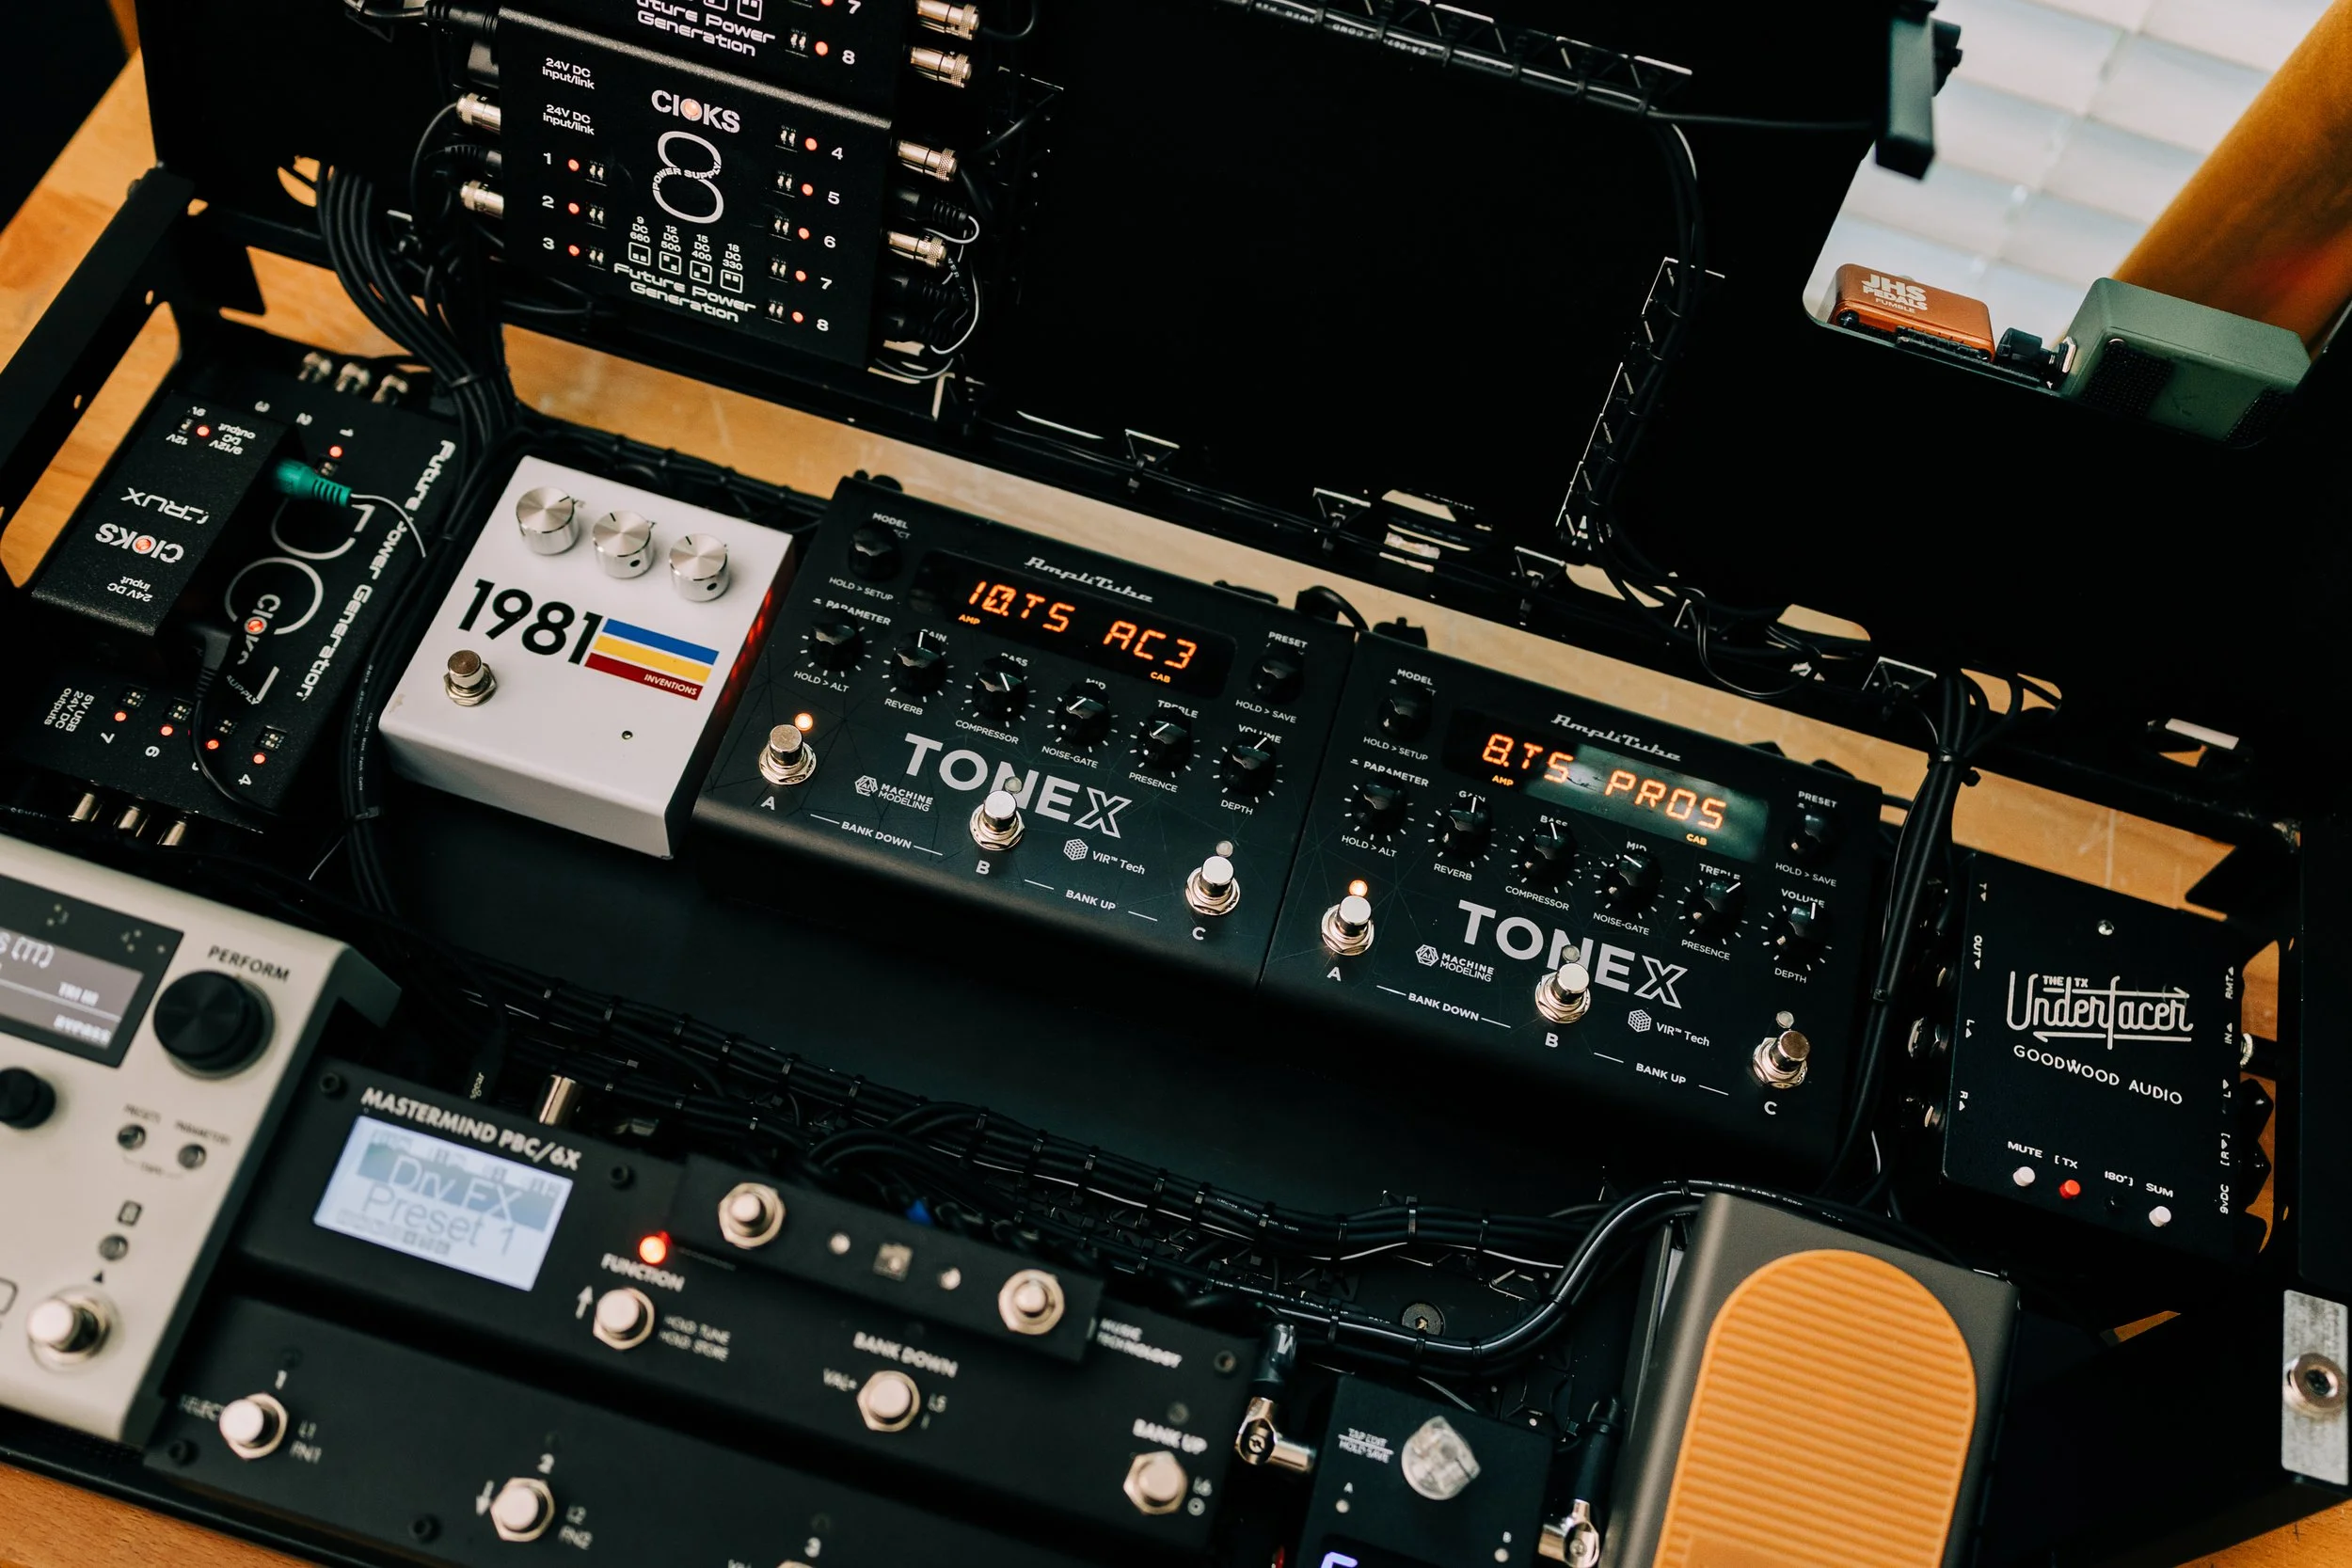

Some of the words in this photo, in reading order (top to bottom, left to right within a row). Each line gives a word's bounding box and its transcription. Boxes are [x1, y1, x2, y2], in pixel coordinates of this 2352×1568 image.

[637, 9, 756, 56] Generation
[705, 13, 776, 43] Power
[545, 56, 571, 75] 24V
[572, 63, 592, 78] DC
[841, 49, 856, 66] 8
[542, 65, 595, 90] input/link
[546, 103, 571, 122] 24V
[572, 110, 592, 125] DC
[651, 89, 741, 134] CIOKS
[543, 112, 595, 136] input/link
[543, 152, 553, 166] 1
[831, 146, 844, 161] 4
[652, 166, 682, 192] POWER
[683, 160, 723, 181] SUPPLY
[541, 195, 555, 209] 2
[827, 190, 841, 206] 5
[630, 231, 651, 245] 660
[632, 224, 649, 235] DC
[662, 232, 679, 244] DC
[664, 225, 678, 235] 12
[695, 233, 709, 244] 15
[542, 236, 555, 250] 3
[660, 241, 682, 253] 500
[693, 242, 710, 253] DC
[726, 243, 739, 253] 18
[823, 235, 837, 249] 6
[691, 249, 712, 262] 400
[722, 259, 743, 271] 330
[724, 250, 741, 261] DC
[613, 262, 687, 293] Future
[691, 286, 756, 313] Power
[819, 277, 834, 291] 7
[1861, 274, 1927, 302] JHS
[630, 281, 739, 323] Generation
[1863, 285, 1928, 310] PEDALS
[816, 318, 830, 333] 8
[254, 400, 271, 413] 3
[295, 411, 313, 426] 2
[167, 434, 188, 447] 12V
[218, 422, 256, 440] output
[221, 434, 242, 446] DC
[339, 428, 355, 438] 1
[209, 439, 244, 456] 9/12V
[404, 439, 457, 512] Future
[119, 486, 210, 526] CRUX
[872, 511, 910, 531] MODEL
[95, 523, 185, 564] CIOKS
[107, 581, 129, 594] DC
[119, 576, 151, 592] input
[828, 576, 855, 592] HOLD
[864, 586, 894, 603] SETUP
[1023, 555, 1154, 605] AmpliTube
[127, 588, 153, 603] 24V
[457, 577, 604, 666] 1981
[958, 612, 982, 626] AMP
[1102, 619, 1199, 671] AC3
[1267, 630, 1310, 650] PRESET
[643, 672, 698, 697] INVENTIONS
[792, 670, 822, 687] HOLD
[829, 680, 850, 693] ALT
[1149, 670, 1172, 685] CAB
[1396, 668, 1434, 687] MODEL
[43, 688, 73, 726] outputs
[68, 690, 85, 713] 24V
[80, 694, 95, 710] 5V
[883, 697, 924, 717] REVERB
[1234, 698, 1263, 714] HOLD
[1271, 709, 1298, 725] SAVE
[54, 711, 72, 731] DC
[65, 708, 87, 733] USB
[101, 732, 115, 744] 7
[954, 720, 1020, 746] COMPRESSOR
[1550, 712, 1682, 763] AmpliTube
[144, 745, 161, 758] 6
[1041, 745, 1100, 769] NOISE-GATE
[1362, 736, 1391, 751] HOLD
[1398, 745, 1430, 763] SETUP
[237, 773, 252, 786] 4
[903, 732, 1133, 839] TONEX
[1128, 770, 1179, 794] PRESENCE
[1491, 774, 1515, 787] AMP
[760, 795, 776, 811] A
[877, 789, 930, 814] MODELING
[881, 782, 934, 805] MACHINE
[1603, 768, 1728, 831] PROS
[1797, 789, 1838, 809] PRESET
[1220, 799, 1254, 816] DEPTH
[840, 820, 875, 839] BANK
[874, 830, 914, 848] DOWN
[1685, 832, 1708, 847] CAB
[1341, 834, 1370, 851] HOLD
[1377, 845, 1398, 859] ALT
[975, 860, 991, 876] B
[1119, 856, 1146, 876] Tech
[1433, 862, 1473, 881] REVERB
[1774, 862, 1804, 878] HOLD
[1811, 873, 1837, 888] SAVE
[1064, 889, 1099, 907] BANK
[1099, 897, 1117, 912] UP
[1504, 884, 1570, 911] COMPRESSOR
[1191, 926, 1207, 942] C
[1592, 911, 1650, 936] NOISE-GATE
[1457, 899, 1689, 1009] TONEX
[1680, 939, 1731, 961] PRESENCE
[1972, 934, 1983, 959] OUT
[207, 943, 292, 984] PERFORM
[1327, 965, 1343, 982] A
[1438, 959, 1493, 983] MODELING
[1440, 952, 1496, 976] MACHINE
[1774, 966, 1808, 985] DEPTH
[2042, 974, 2065, 987] THE
[2074, 976, 2090, 989] TX
[2223, 974, 2235, 1001] RMT
[1407, 991, 1440, 1010] BANK
[1441, 1002, 1480, 1022] DOWN
[2006, 970, 2194, 1051] Underfacer
[1544, 1032, 1559, 1049] B
[1683, 1031, 1710, 1048] Tech
[1635, 1062, 1670, 1081] BANK
[1670, 1071, 1687, 1086] UP
[2013, 1043, 2121, 1086] GOODWOOD
[2127, 1078, 2184, 1106] AUDIO
[1763, 1100, 1778, 1117] C
[359, 1085, 499, 1145] MASTERMIND
[498, 1128, 583, 1173] PBC/6X
[2007, 1139, 2044, 1160] MUTE
[2145, 1181, 2175, 1198] SUM
[361, 1183, 485, 1248] Preset
[500, 1225, 517, 1258] 1
[599, 1251, 686, 1292] FUNCTION
[852, 1330, 901, 1360] BANK
[901, 1346, 960, 1379] DOWN
[1131, 1417, 1181, 1450] BANK
[1181, 1432, 1209, 1456] UP
[1343, 1481, 1355, 1495] A
